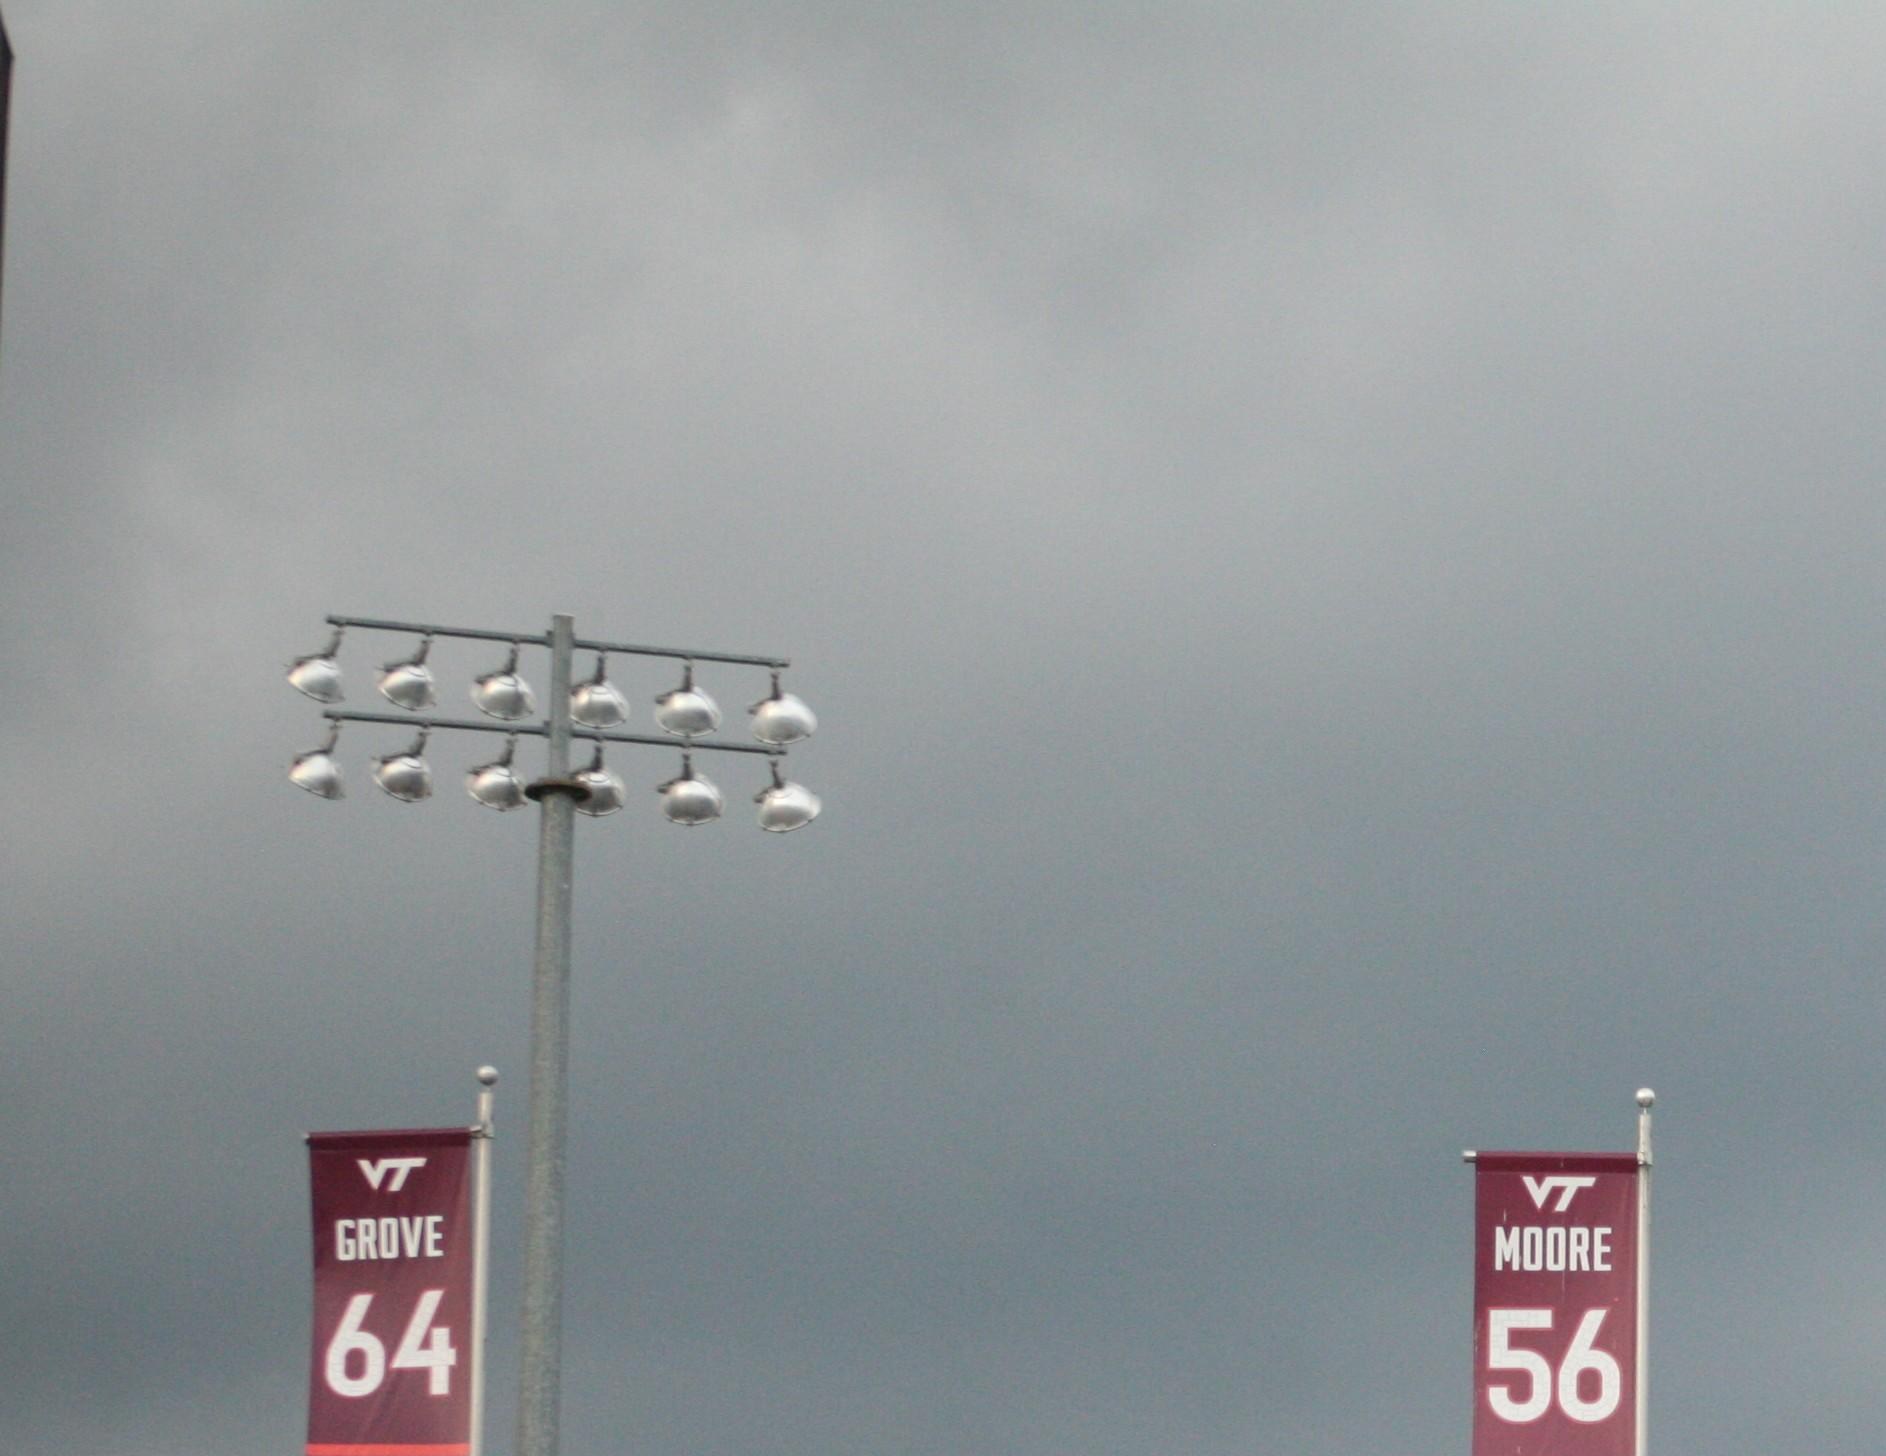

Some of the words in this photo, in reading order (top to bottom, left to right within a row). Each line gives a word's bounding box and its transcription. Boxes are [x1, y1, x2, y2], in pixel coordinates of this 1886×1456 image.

[336, 1215, 444, 1261] GROVE
[1495, 1227, 1612, 1272] MOORE
[325, 1290, 456, 1398] 64
[1487, 1309, 1621, 1424] 56
